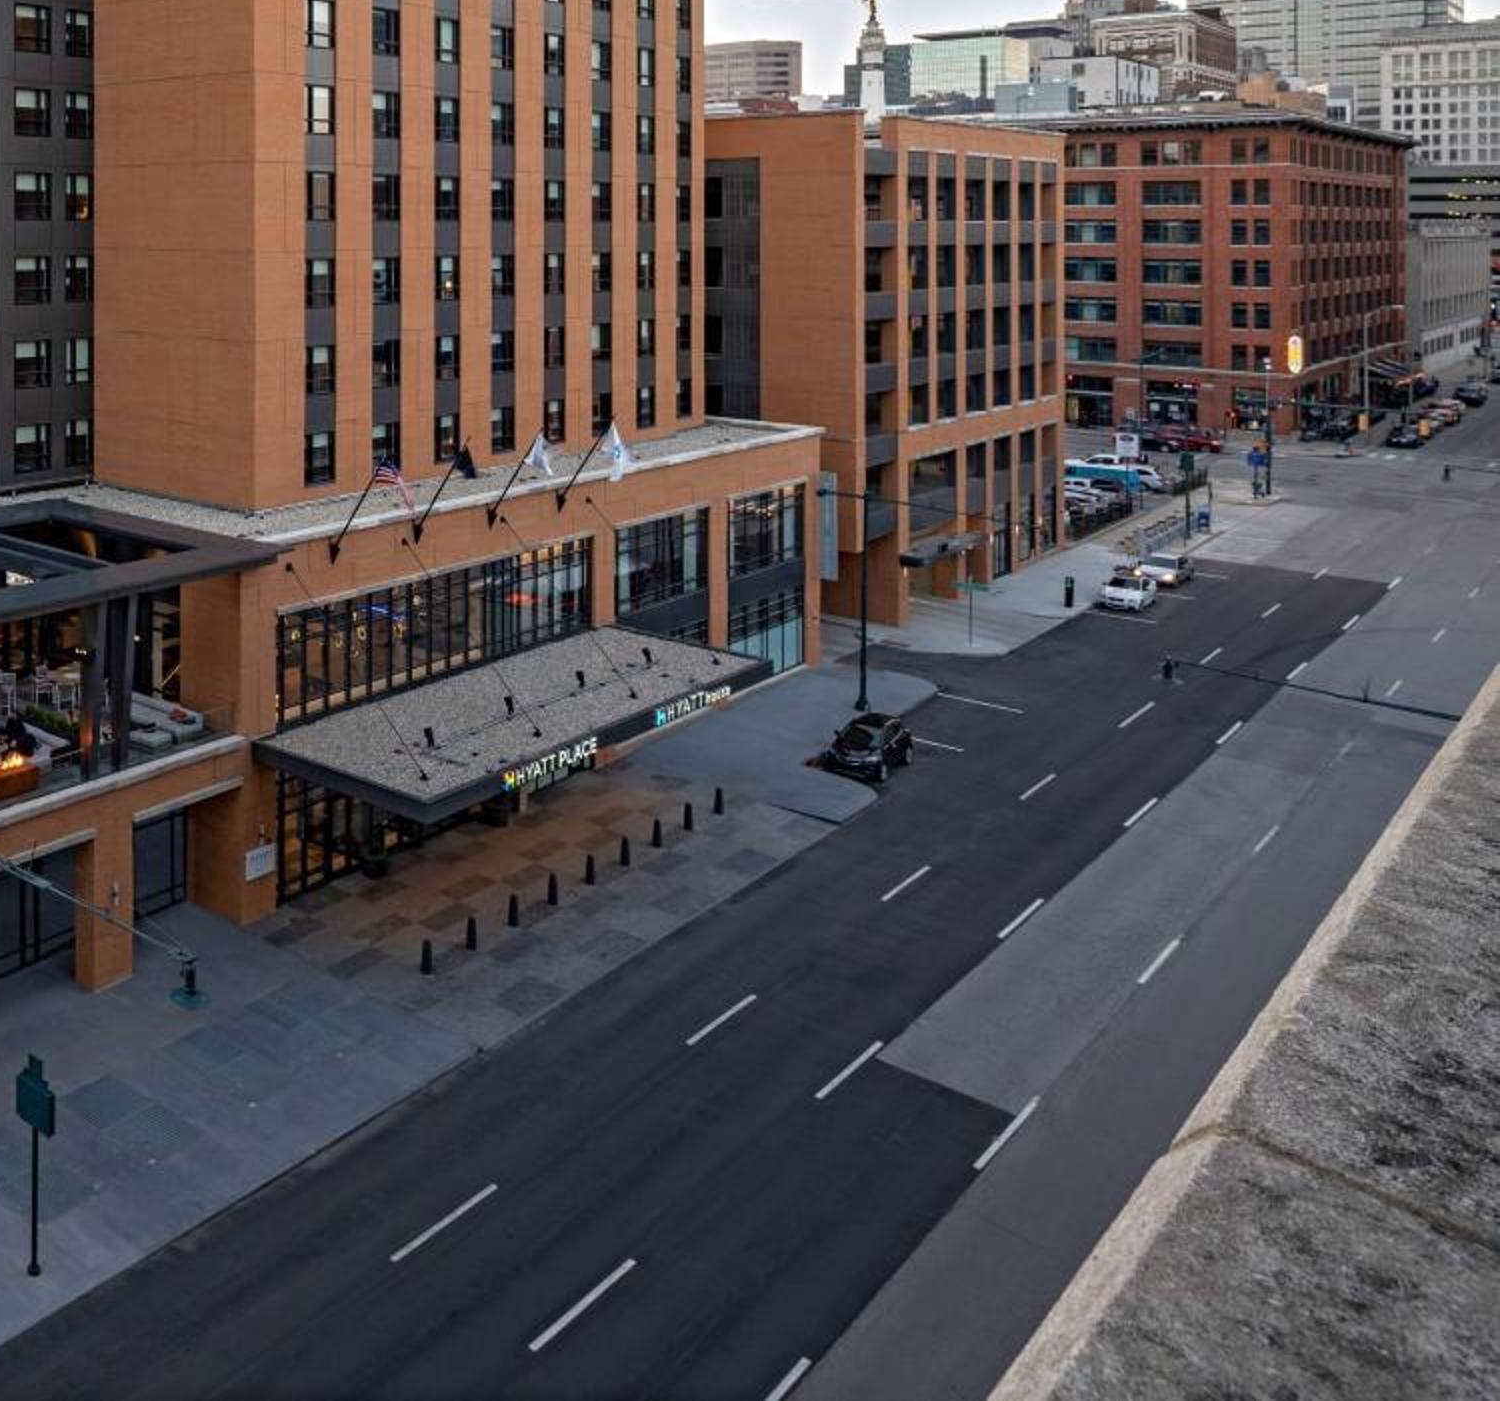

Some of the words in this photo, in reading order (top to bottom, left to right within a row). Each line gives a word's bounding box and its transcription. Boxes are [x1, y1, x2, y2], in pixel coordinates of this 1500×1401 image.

[667, 690, 706, 722] HYATT
[515, 753, 557, 786] HYATT
[559, 736, 598, 768] PLACE
